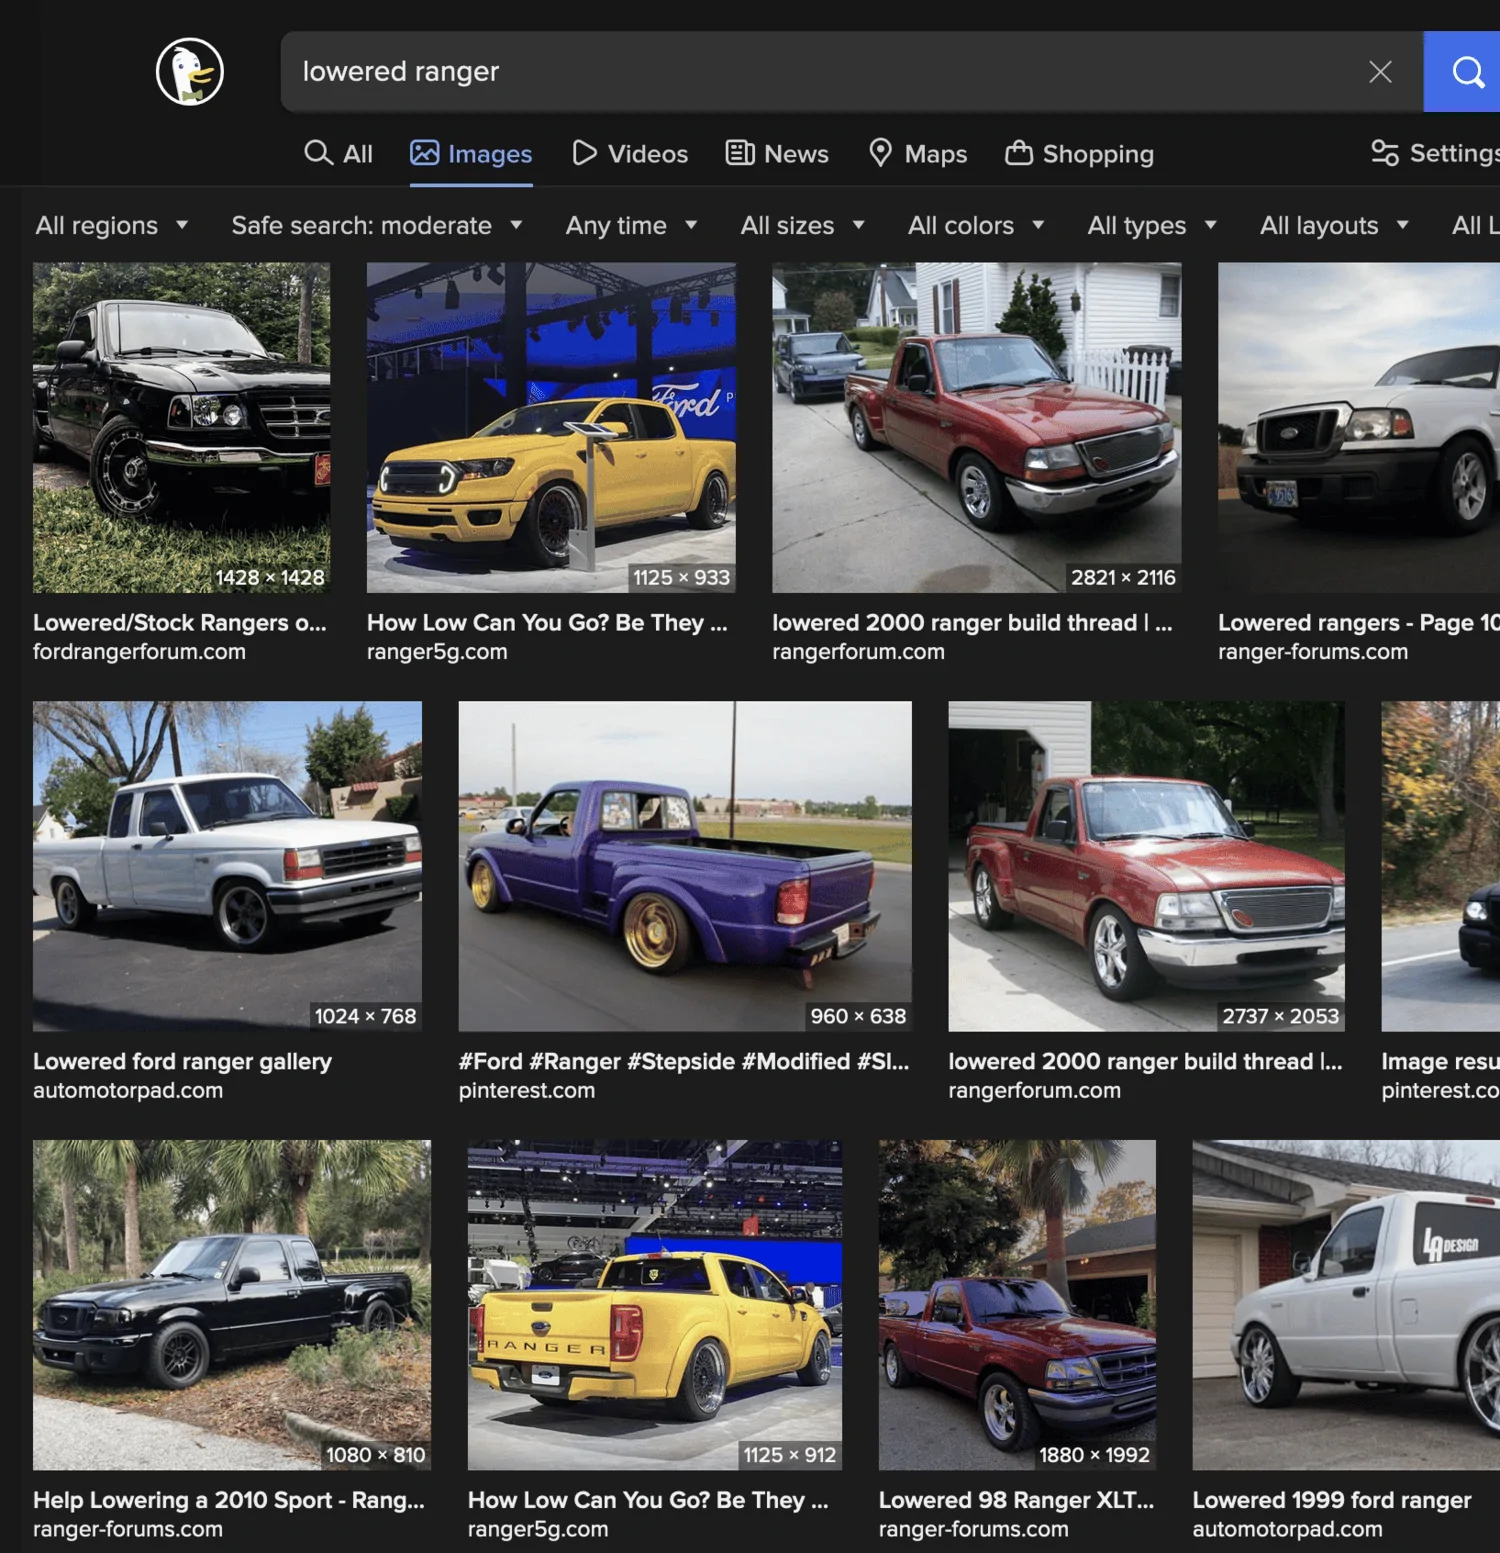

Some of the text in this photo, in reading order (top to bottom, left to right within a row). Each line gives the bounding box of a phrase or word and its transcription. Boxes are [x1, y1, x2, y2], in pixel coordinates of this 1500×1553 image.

[303, 59, 500, 88] lowered ranger
[342, 144, 373, 164] All
[449, 144, 533, 169] Images
[607, 144, 689, 164] Videos
[765, 144, 830, 164] News
[905, 144, 968, 169] Maps
[1043, 143, 1154, 169] Shopping
[34, 215, 159, 241] All regions
[232, 214, 493, 236] Safe search: moderate
[565, 215, 668, 241] Any time
[740, 214, 835, 236] All sizes
[907, 215, 1015, 235] All colors
[1087, 215, 1187, 241] All types
[1259, 215, 1379, 241] All layouts
[1451, 215, 1481, 235] All
[216, 569, 325, 586] 1428 1428
[1072, 569, 1176, 585] 2821 2116
[33, 612, 195, 633] Lowered/Stock
[201, 613, 289, 637] Rangers
[367, 612, 705, 637] How Low Can You Go? Be They
[772, 612, 1138, 637] lowered 2000 ranger build thread
[1218, 613, 1312, 632] Lowered
[1318, 617, 1401, 637] rangers
[1420, 613, 1475, 637] Page
[32, 641, 246, 665] fordrangerforum.com
[367, 642, 508, 665] ranger5g.com
[772, 641, 945, 665] rangerforum.com
[1218, 641, 1409, 665] ranger-forums.com
[811, 1008, 906, 1024] 960 638
[1223, 1008, 1339, 1024] 2737 2053
[33, 1051, 333, 1075] Lowered ford ranger gallery
[458, 1051, 523, 1071] #Ford
[528, 1051, 622, 1075] #Ranger
[626, 1051, 736, 1075] #Stepside
[741, 1051, 851, 1071] #Modified
[1382, 1051, 1449, 1075] Image
[33, 1081, 224, 1103] automotorpad.com
[459, 1081, 596, 1103] pinterest.com
[948, 1080, 1121, 1104] rangerforum.com
[487, 1340, 606, 1355] RANGER
[327, 1447, 426, 1463] 1080 810
[33, 1490, 85, 1514] Help
[90, 1490, 189, 1514] Lowering
[195, 1494, 209, 1510] a
[214, 1490, 268, 1509] 2010
[273, 1490, 334, 1514] Sport
[879, 1490, 972, 1510] Lowered
[978, 1490, 1008, 1510] 98
[1013, 1490, 1092, 1514] Ranger
[1193, 1490, 1473, 1514] Lowered 1999 ford ranger
[33, 1519, 223, 1542] ranger-forums.com
[468, 1519, 609, 1542] ranger5g.com
[879, 1519, 1069, 1542] ranger-forums.com
[1192, 1519, 1383, 1542] automotorpad.com
